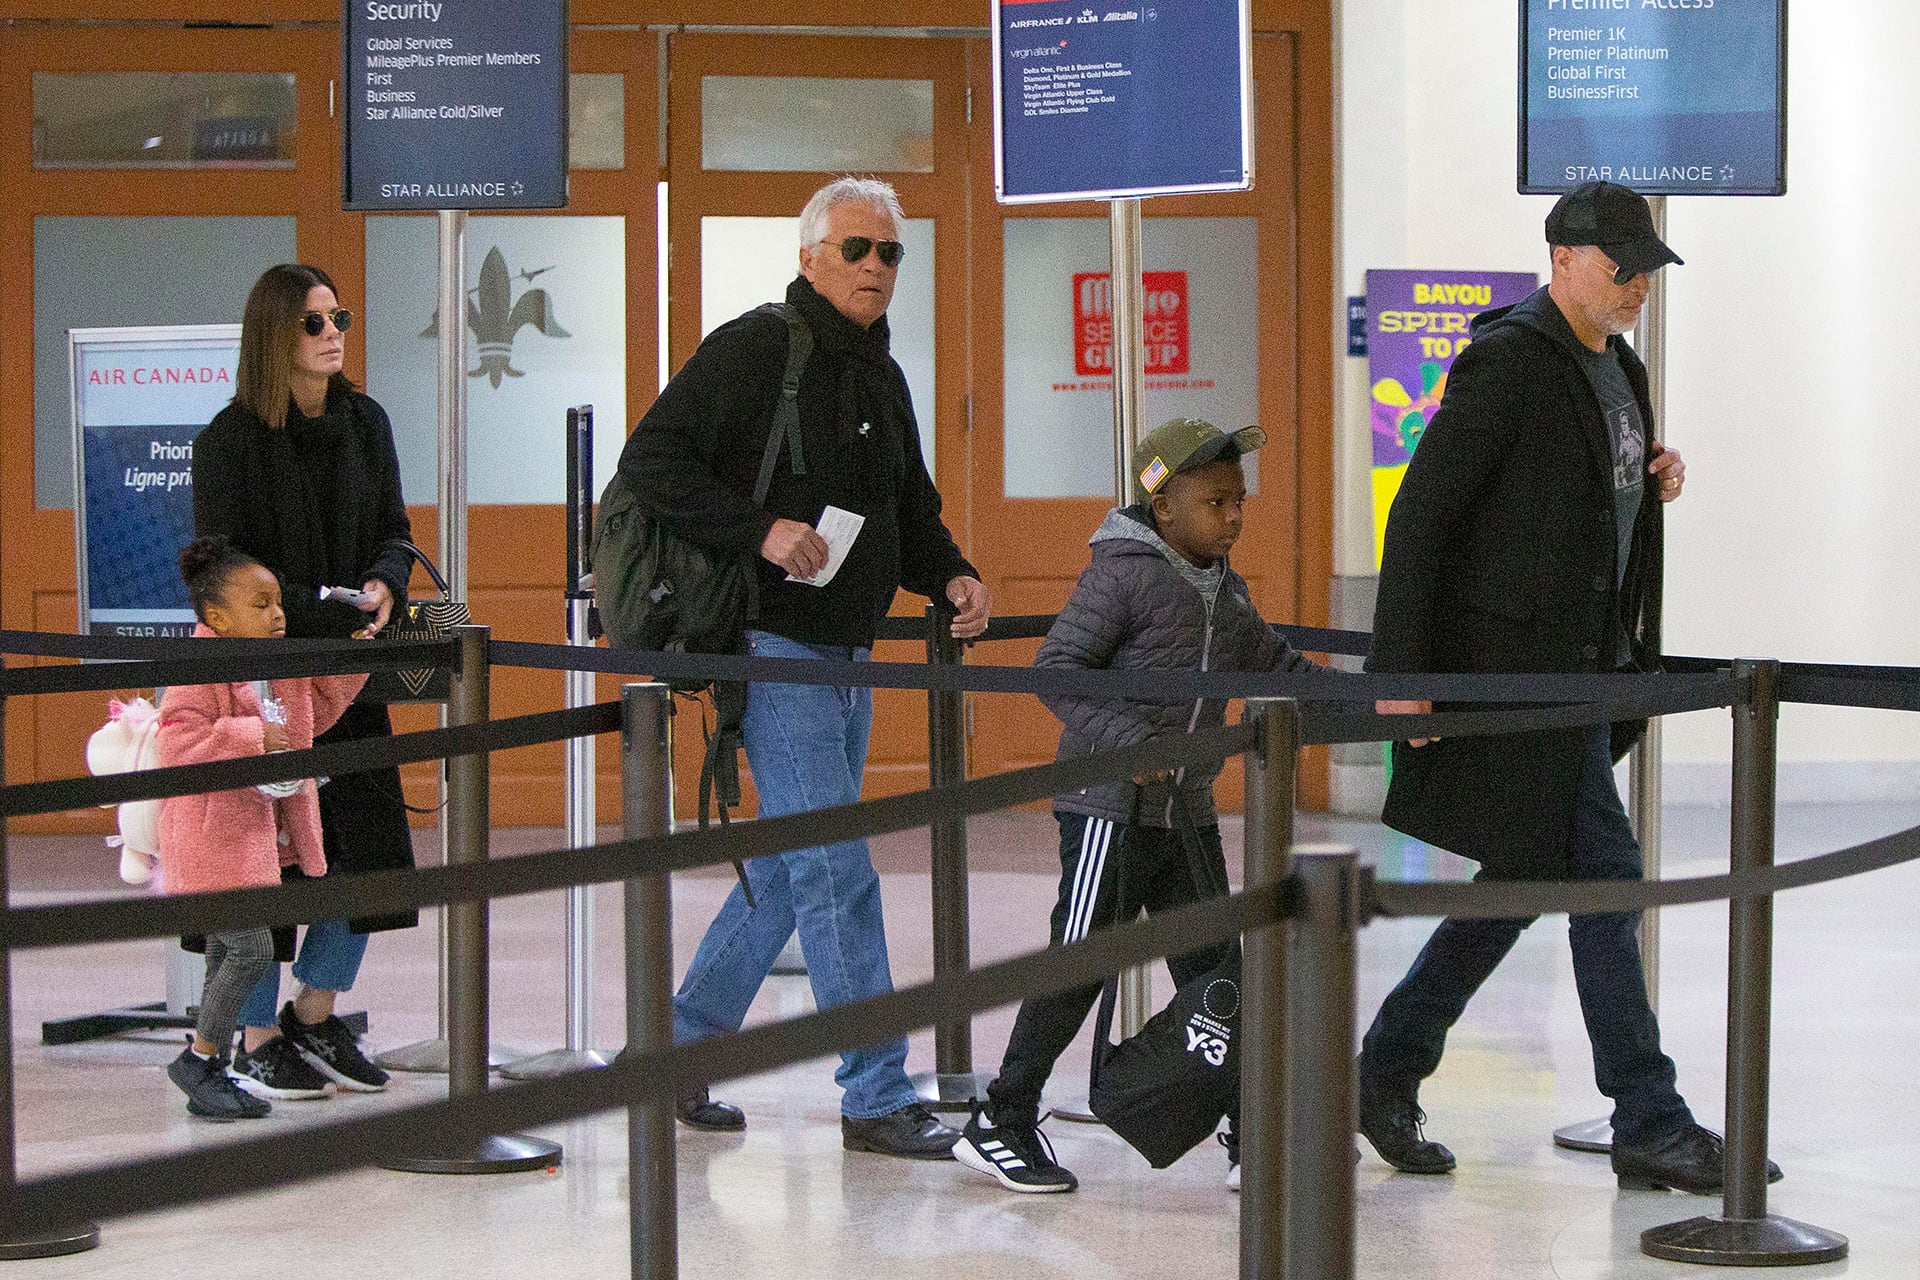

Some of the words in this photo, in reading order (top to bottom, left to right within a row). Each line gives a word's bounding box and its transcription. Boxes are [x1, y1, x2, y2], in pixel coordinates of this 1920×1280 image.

[367, 0, 442, 22] Security
[1077, 15, 1098, 24] KLM
[1103, 11, 1138, 21] Alitalia
[1548, 27, 1602, 41] Premier
[1608, 27, 1626, 41] 1K
[367, 38, 402, 50] Global
[405, 36, 453, 49] Services
[367, 54, 434, 69] MileagePlus
[437, 53, 484, 67] Premier
[486, 52, 541, 65] Members
[1548, 47, 1602, 60] Premier
[1607, 46, 1669, 60] Platinum
[1077, 63, 1104, 71] Business
[1102, 70, 1131, 78] Medallion
[1548, 65, 1591, 80] Global
[1596, 65, 1626, 80] First
[367, 73, 392, 85] First
[367, 90, 416, 102] Business
[1548, 85, 1639, 99] BusinessFirst
[1067, 98, 1085, 106] Flying
[367, 108, 389, 120] Star
[391, 106, 437, 119] Alliance
[440, 105, 504, 120] Gold/Silver
[1565, 166, 1612, 181] STAR
[1619, 166, 1713, 181] ALLIANCE
[381, 184, 422, 197] STAR
[426, 182, 506, 197] ALLIANCE
[1414, 283, 1492, 306] BAYOU
[1378, 311, 1477, 333] SPIR
[1084, 320, 1178, 343] SEICE
[1420, 336, 1452, 359] TO
[88, 368, 126, 385] AIR
[133, 367, 230, 385] CANADA
[151, 440, 193, 460] Priori
[124, 467, 166, 492] Ligne
[167, 467, 193, 492] pri
[116, 627, 156, 638] STAR
[1186, 1025, 1228, 1066] Y-3
